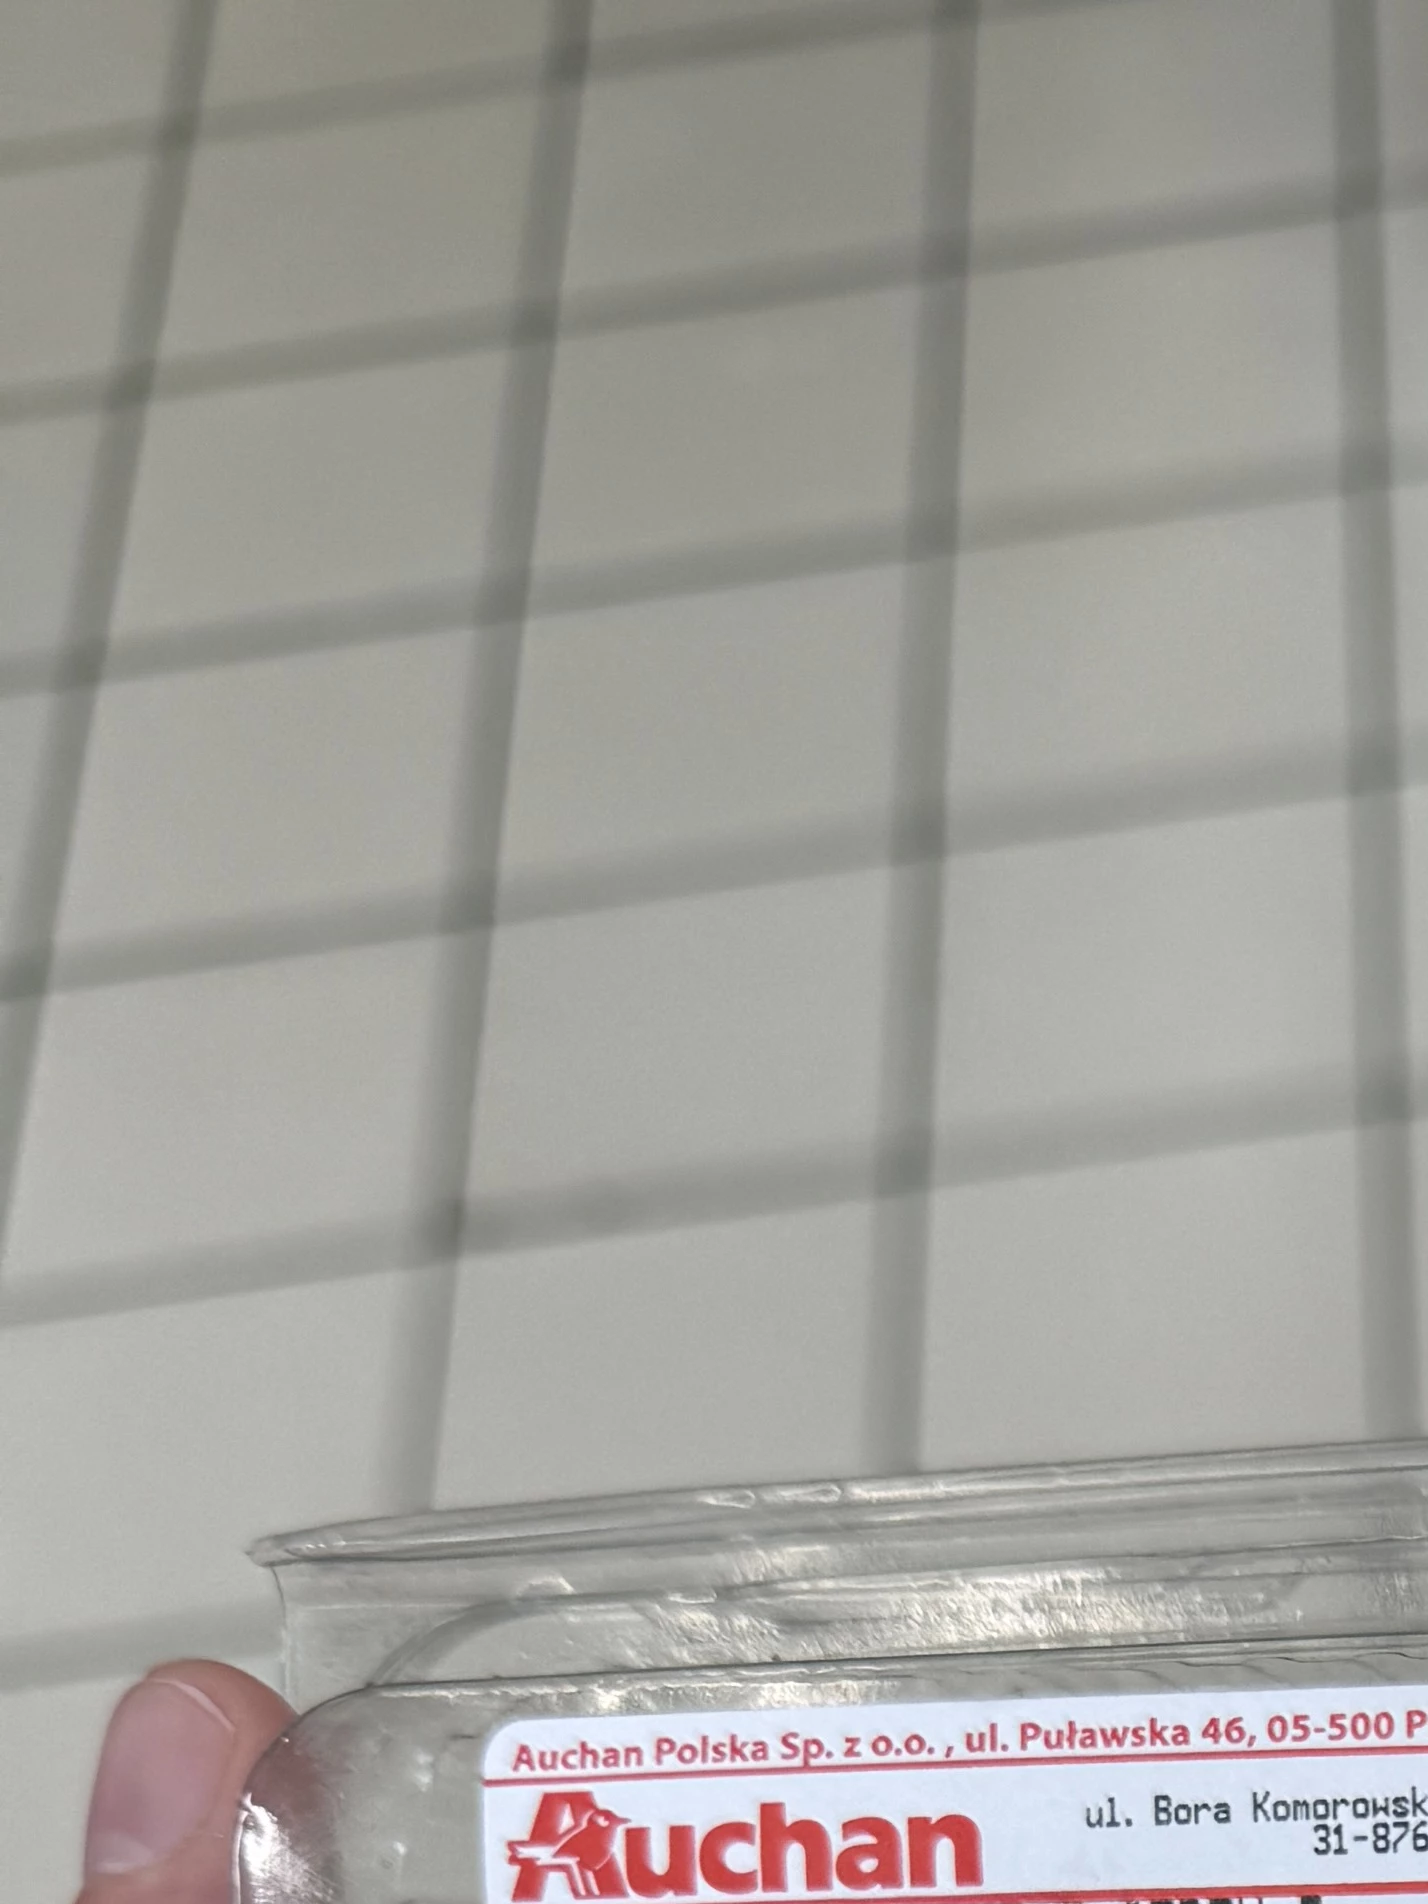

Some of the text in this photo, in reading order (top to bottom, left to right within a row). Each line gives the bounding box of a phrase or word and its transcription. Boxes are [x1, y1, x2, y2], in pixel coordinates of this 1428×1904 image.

[512, 1740, 644, 1773] Auchan
[654, 1733, 770, 1767] Polska
[780, 1731, 834, 1767] Sp.
[844, 1736, 861, 1759] z
[870, 1732, 936, 1757] o.o.
[964, 1722, 1010, 1754] ul.
[1018, 1717, 1191, 1753] Puławska
[1200, 1716, 1257, 1749] 46,
[1266, 1710, 1395, 1743] 05-500
[1086, 1797, 1132, 1828] ul.
[1154, 1795, 1230, 1825] Bora
[506, 1790, 984, 1902] Auchan
[1314, 1821, 1428, 1855] 31-876
